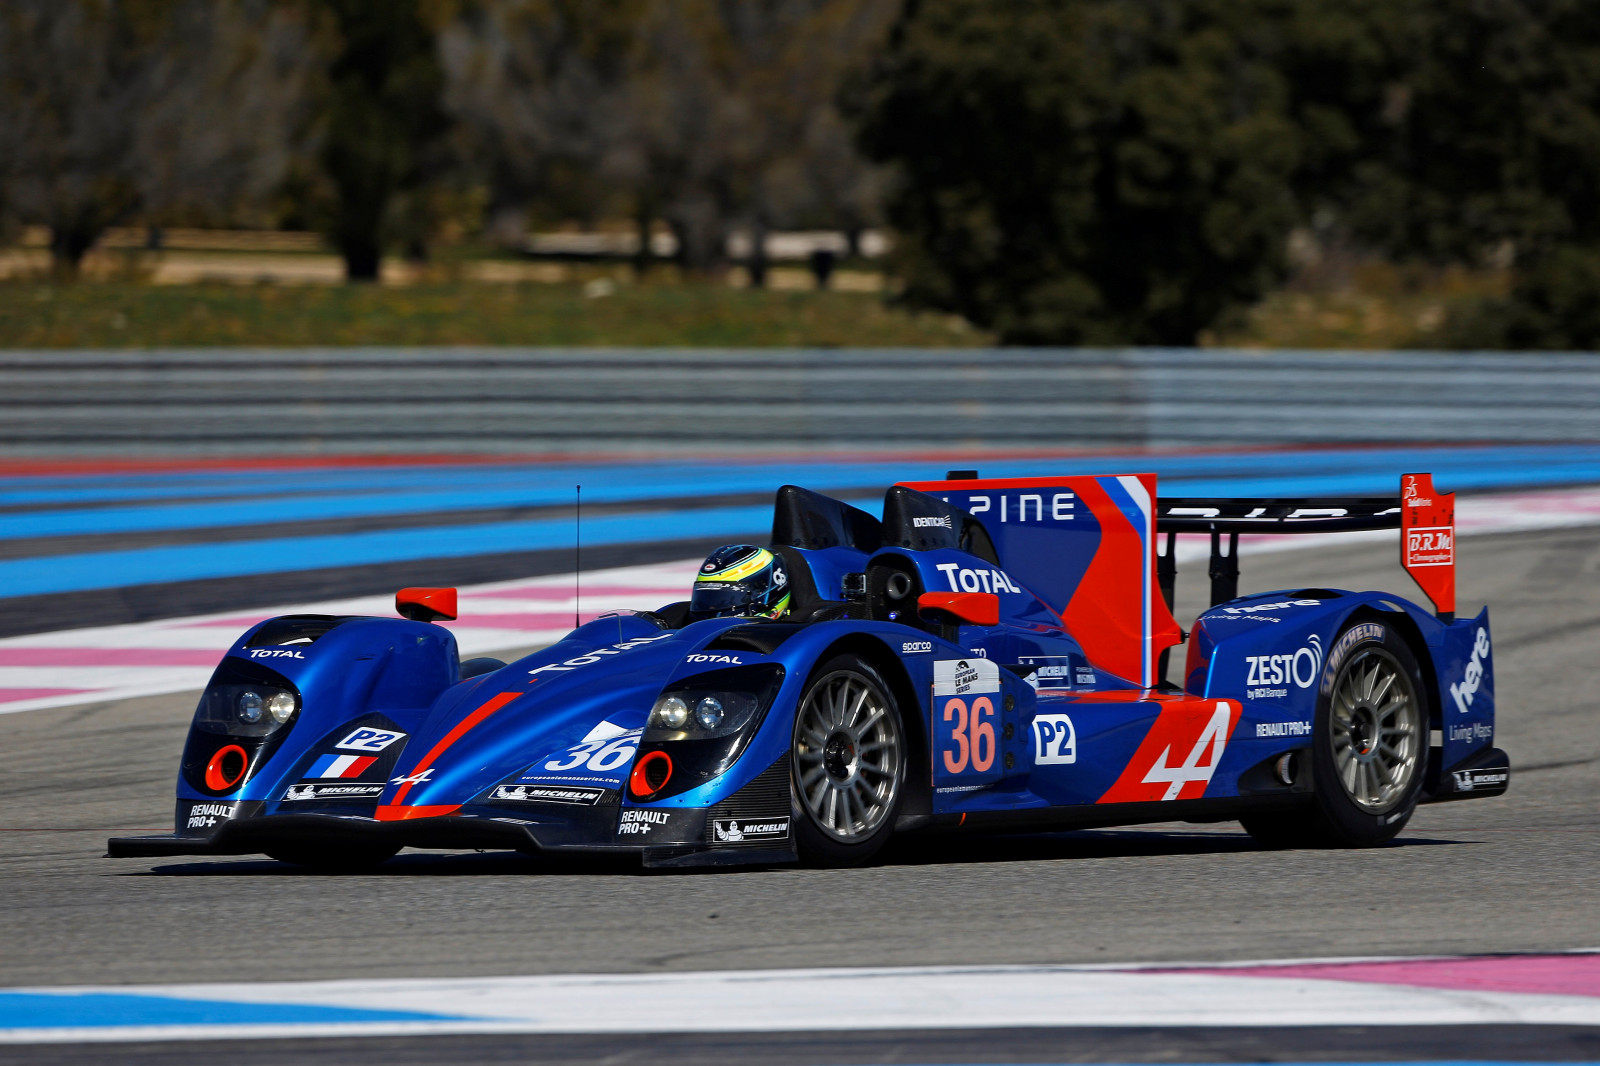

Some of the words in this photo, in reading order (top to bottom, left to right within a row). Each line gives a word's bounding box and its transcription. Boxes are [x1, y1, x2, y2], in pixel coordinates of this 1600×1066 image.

[936, 563, 1022, 593] TOTAL
[1223, 599, 1321, 614] here
[1243, 615, 1281, 623] Maps
[902, 641, 932, 653] sparco
[1329, 624, 1384, 669] MICHELIN
[250, 649, 305, 659] TOTAL
[528, 633, 673, 675] TOTAL
[686, 653, 743, 665] TOTAL
[955, 668, 976, 679] EUROPEAN
[1246, 647, 1317, 688] ZESTO
[1450, 627, 1490, 713] here
[955, 679, 961, 687] LE
[962, 673, 979, 684] MANS
[956, 684, 970, 695] SERIES
[1247, 689, 1254, 700] by
[1266, 688, 1288, 699] Banque
[943, 696, 996, 774] 36
[1256, 723, 1289, 737] RENAULT
[1449, 724, 1473, 743] Living
[1473, 722, 1492, 742] Maps
[344, 730, 395, 748] P2
[1036, 720, 1073, 757] P2
[544, 735, 642, 771] 36
[1474, 774, 1508, 783] MICHELIN
[318, 786, 384, 795] MICHELIN
[529, 789, 598, 800] MICHELIN
[191, 804, 235, 818] RENAULT
[621, 810, 670, 824] RENAULT
[743, 823, 788, 833] MICHELIN
